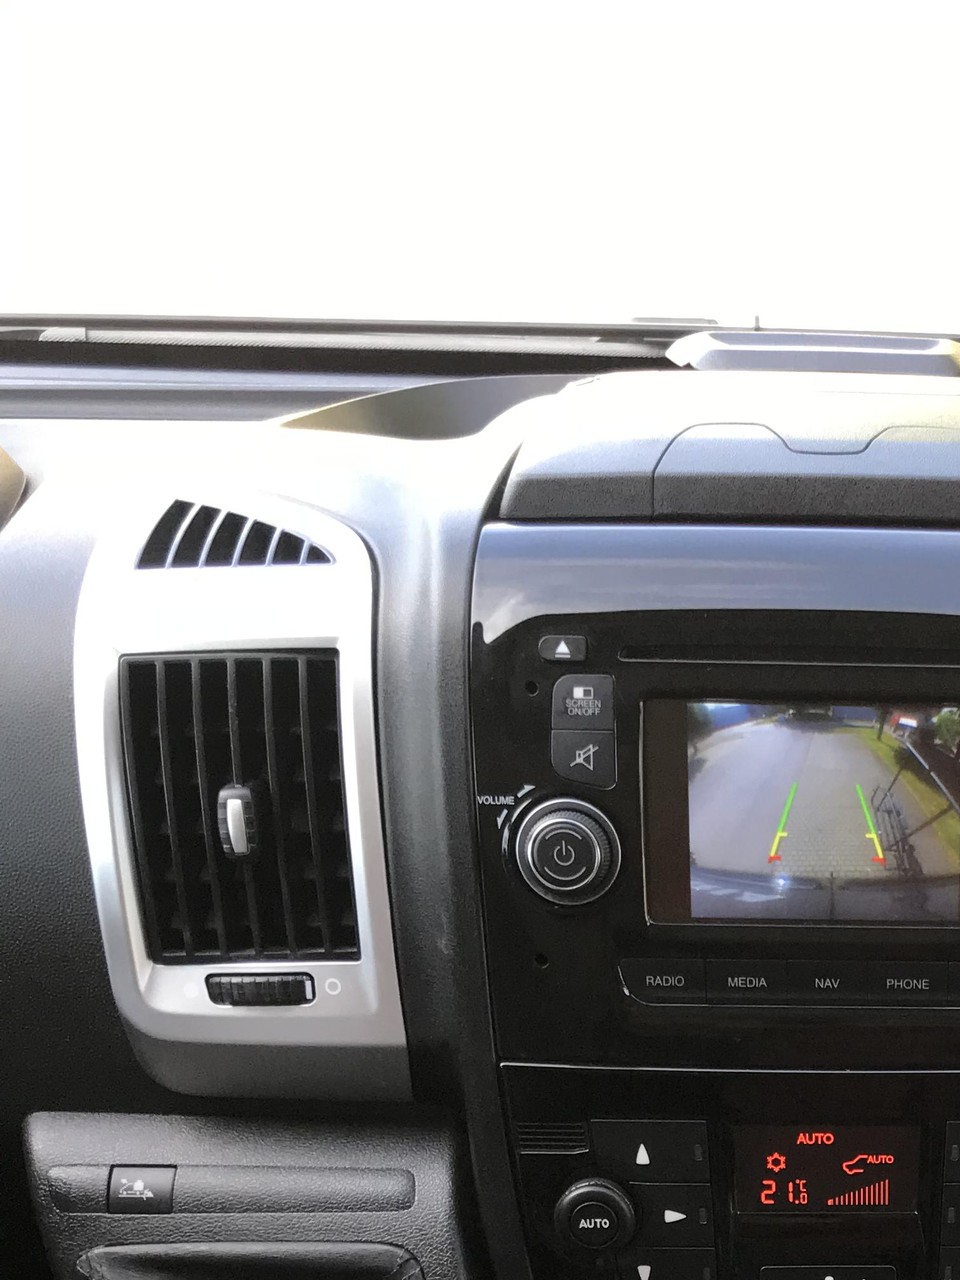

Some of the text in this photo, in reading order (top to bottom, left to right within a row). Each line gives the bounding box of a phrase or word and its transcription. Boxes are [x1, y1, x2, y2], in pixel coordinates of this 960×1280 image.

[565, 699, 601, 708] SCREEN
[567, 708, 600, 716] ON/OFF
[477, 796, 515, 805] VOLUME
[646, 975, 685, 987] RADIO
[727, 977, 768, 988] MEDIA
[815, 978, 840, 989] NAV
[886, 978, 930, 990] PHONE
[796, 1133, 835, 1145] AUTO
[867, 1155, 894, 1164] AUTO
[579, 1218, 610, 1229] AUTO
